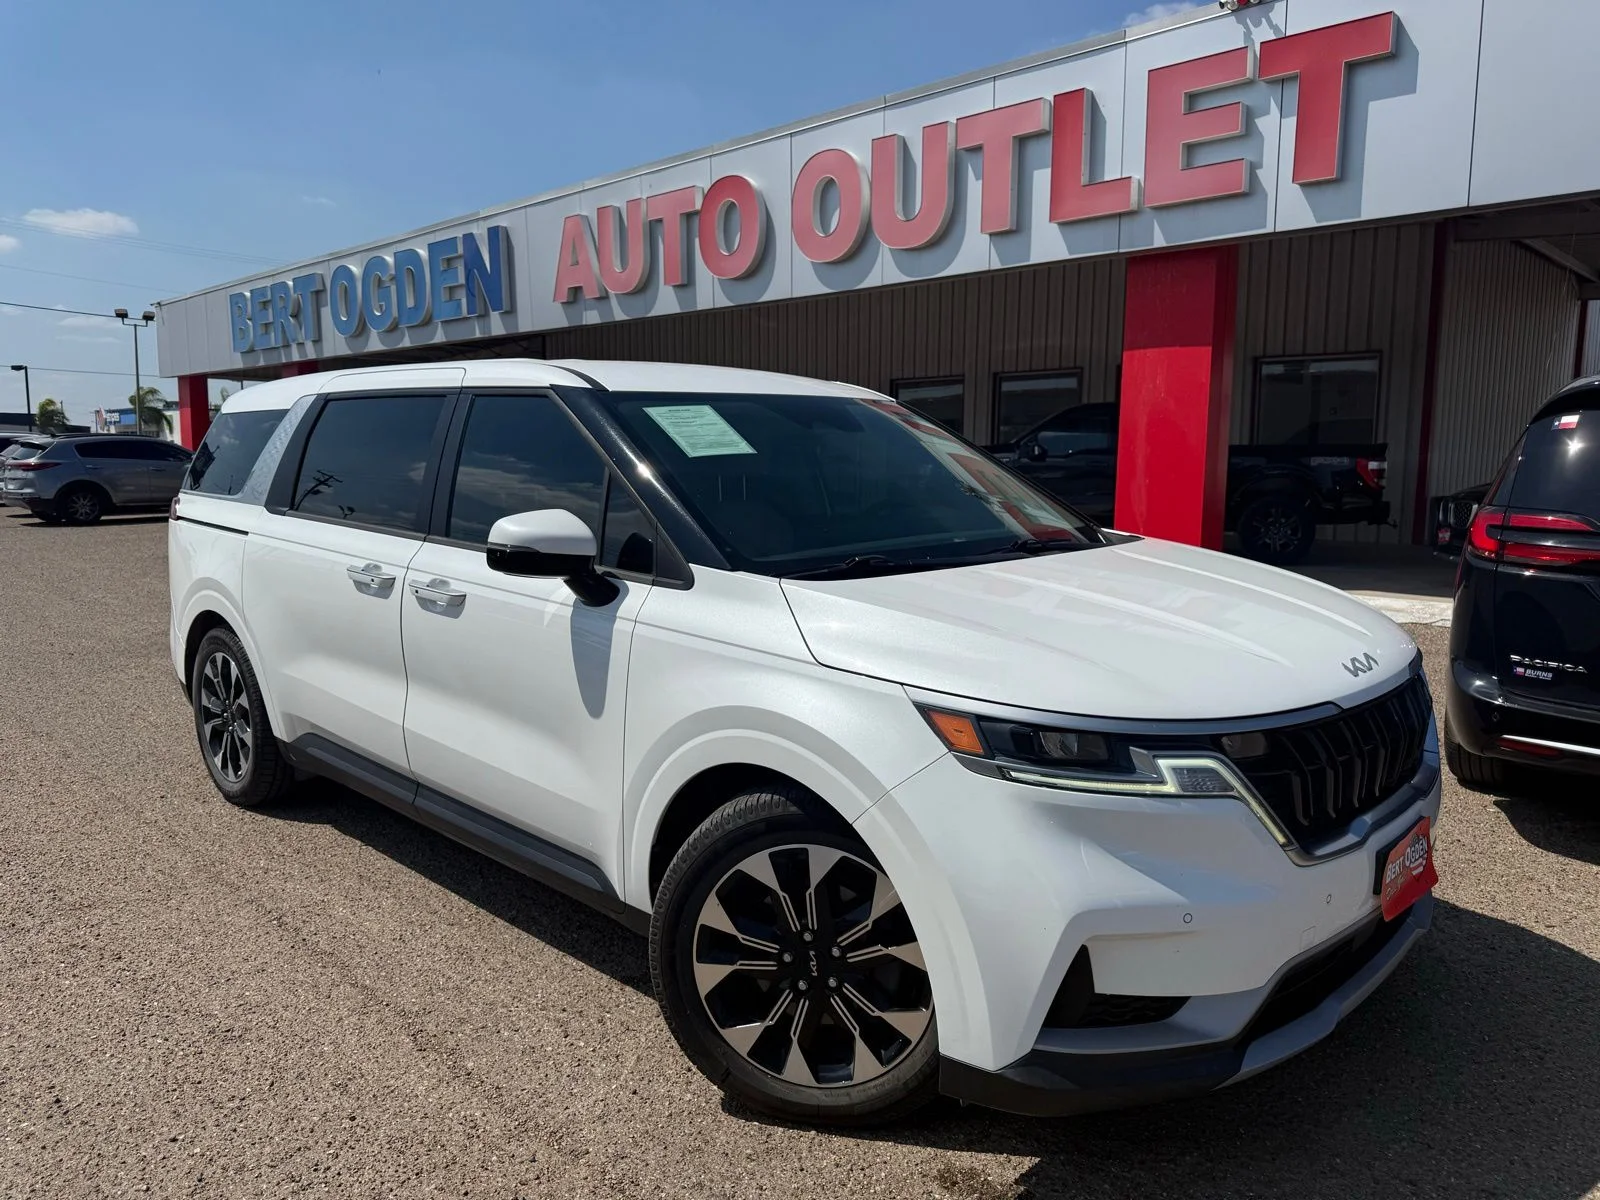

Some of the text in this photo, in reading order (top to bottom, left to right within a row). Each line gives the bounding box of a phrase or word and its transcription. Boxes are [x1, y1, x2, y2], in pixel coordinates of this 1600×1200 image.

[229, 11, 1398, 353] BERT OGDEN AUTO OUTLET
[1510, 654, 1588, 673] PACIFICA
[1526, 668, 1553, 678] BURNS
[1386, 837, 1428, 884] BERT OGDEN
